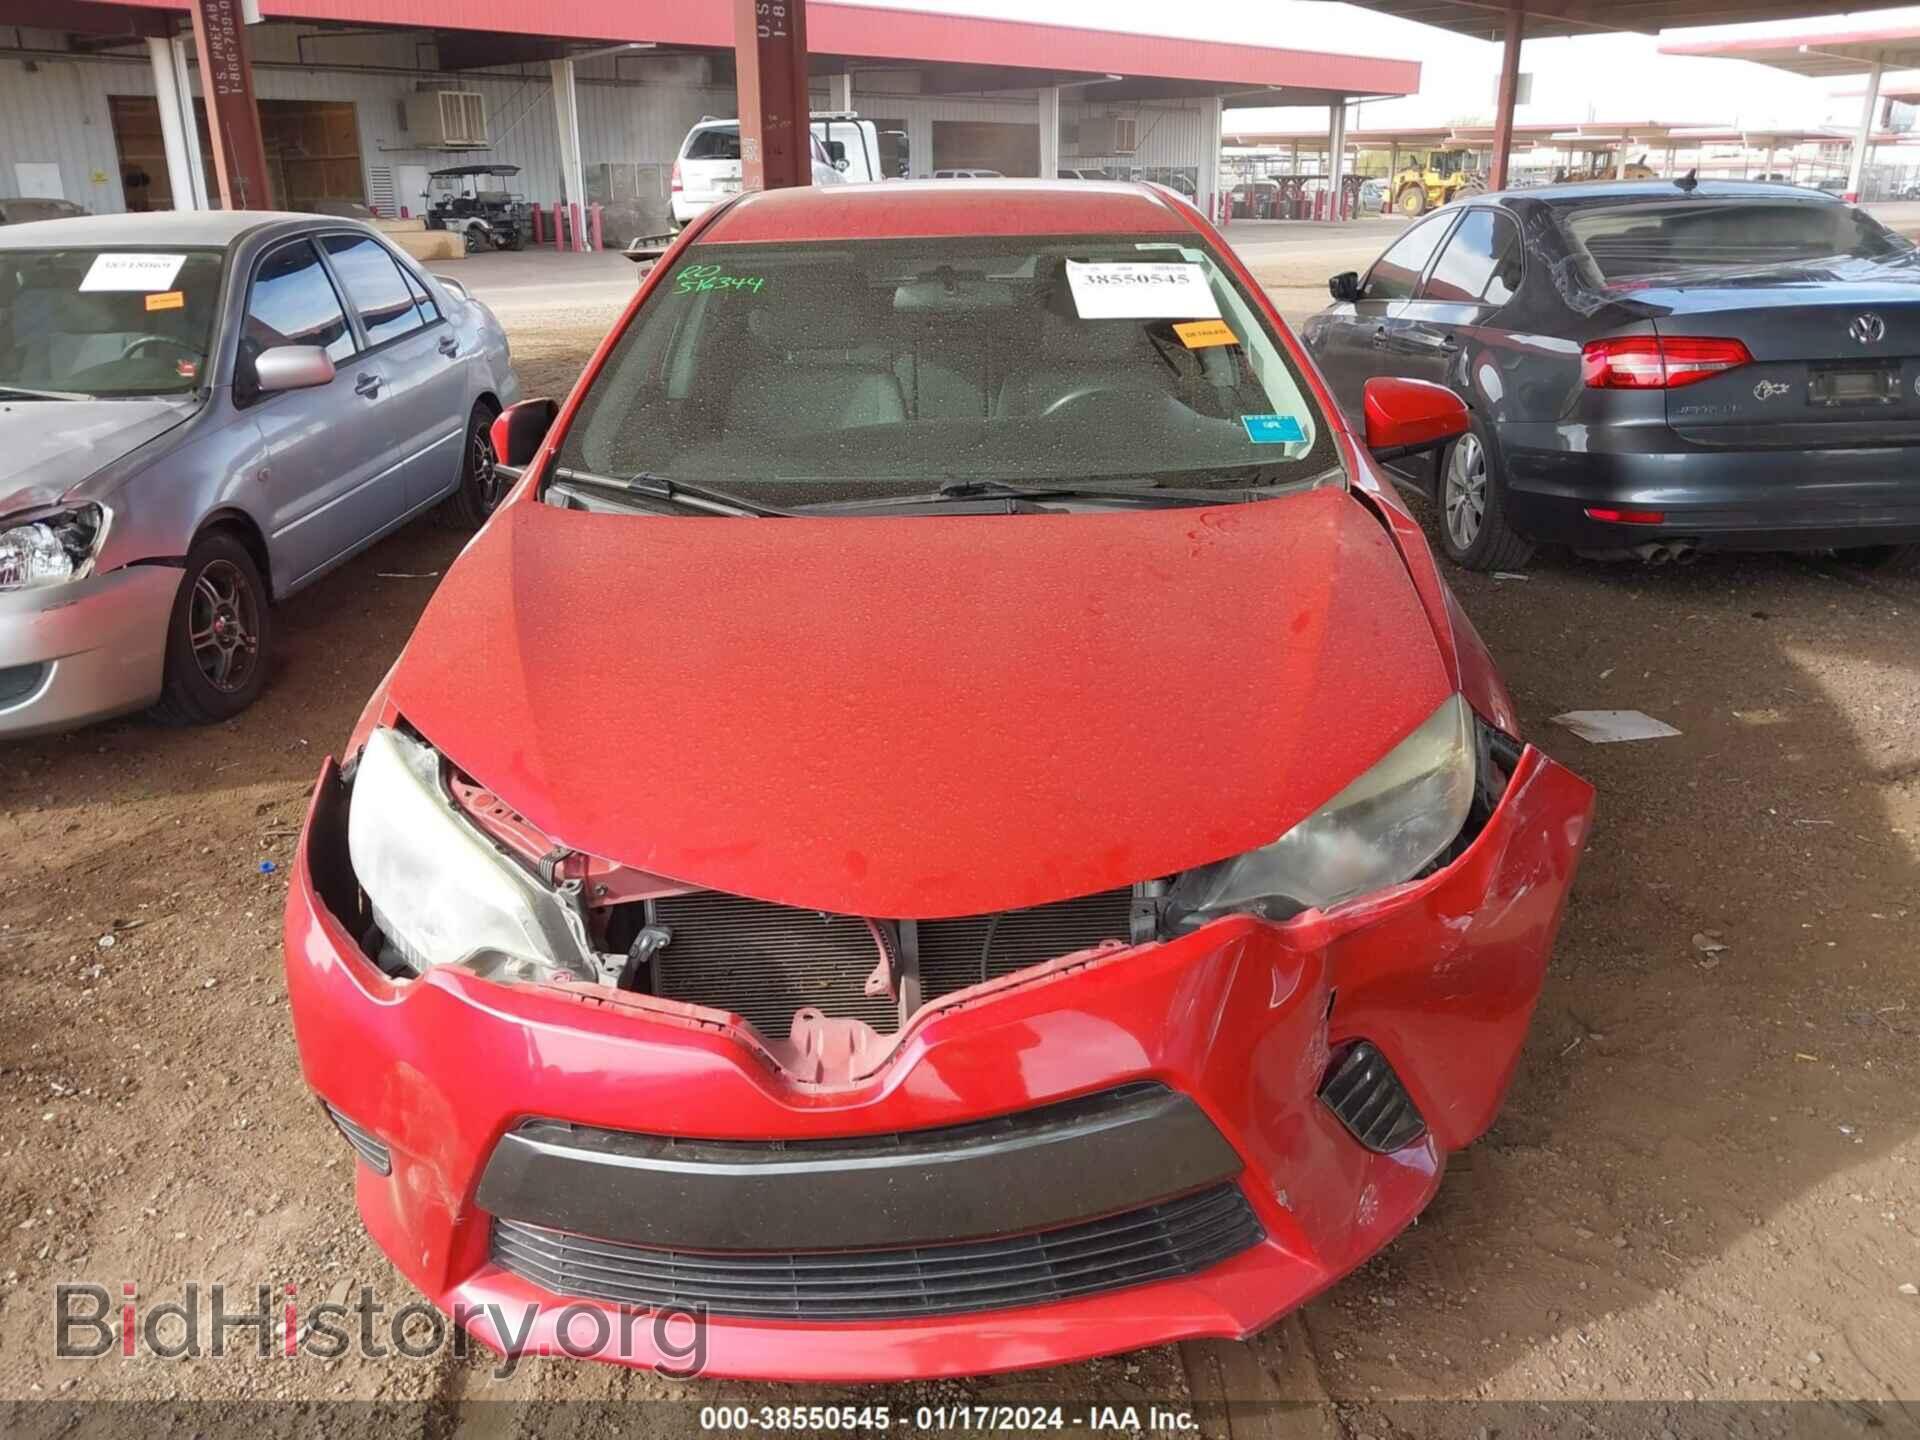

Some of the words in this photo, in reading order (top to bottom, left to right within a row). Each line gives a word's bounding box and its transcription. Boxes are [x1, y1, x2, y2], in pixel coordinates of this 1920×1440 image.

[206, 3, 225, 61] PREFAB
[772, 0, 787, 37] 1-8
[1083, 273, 1190, 287] 38550545
